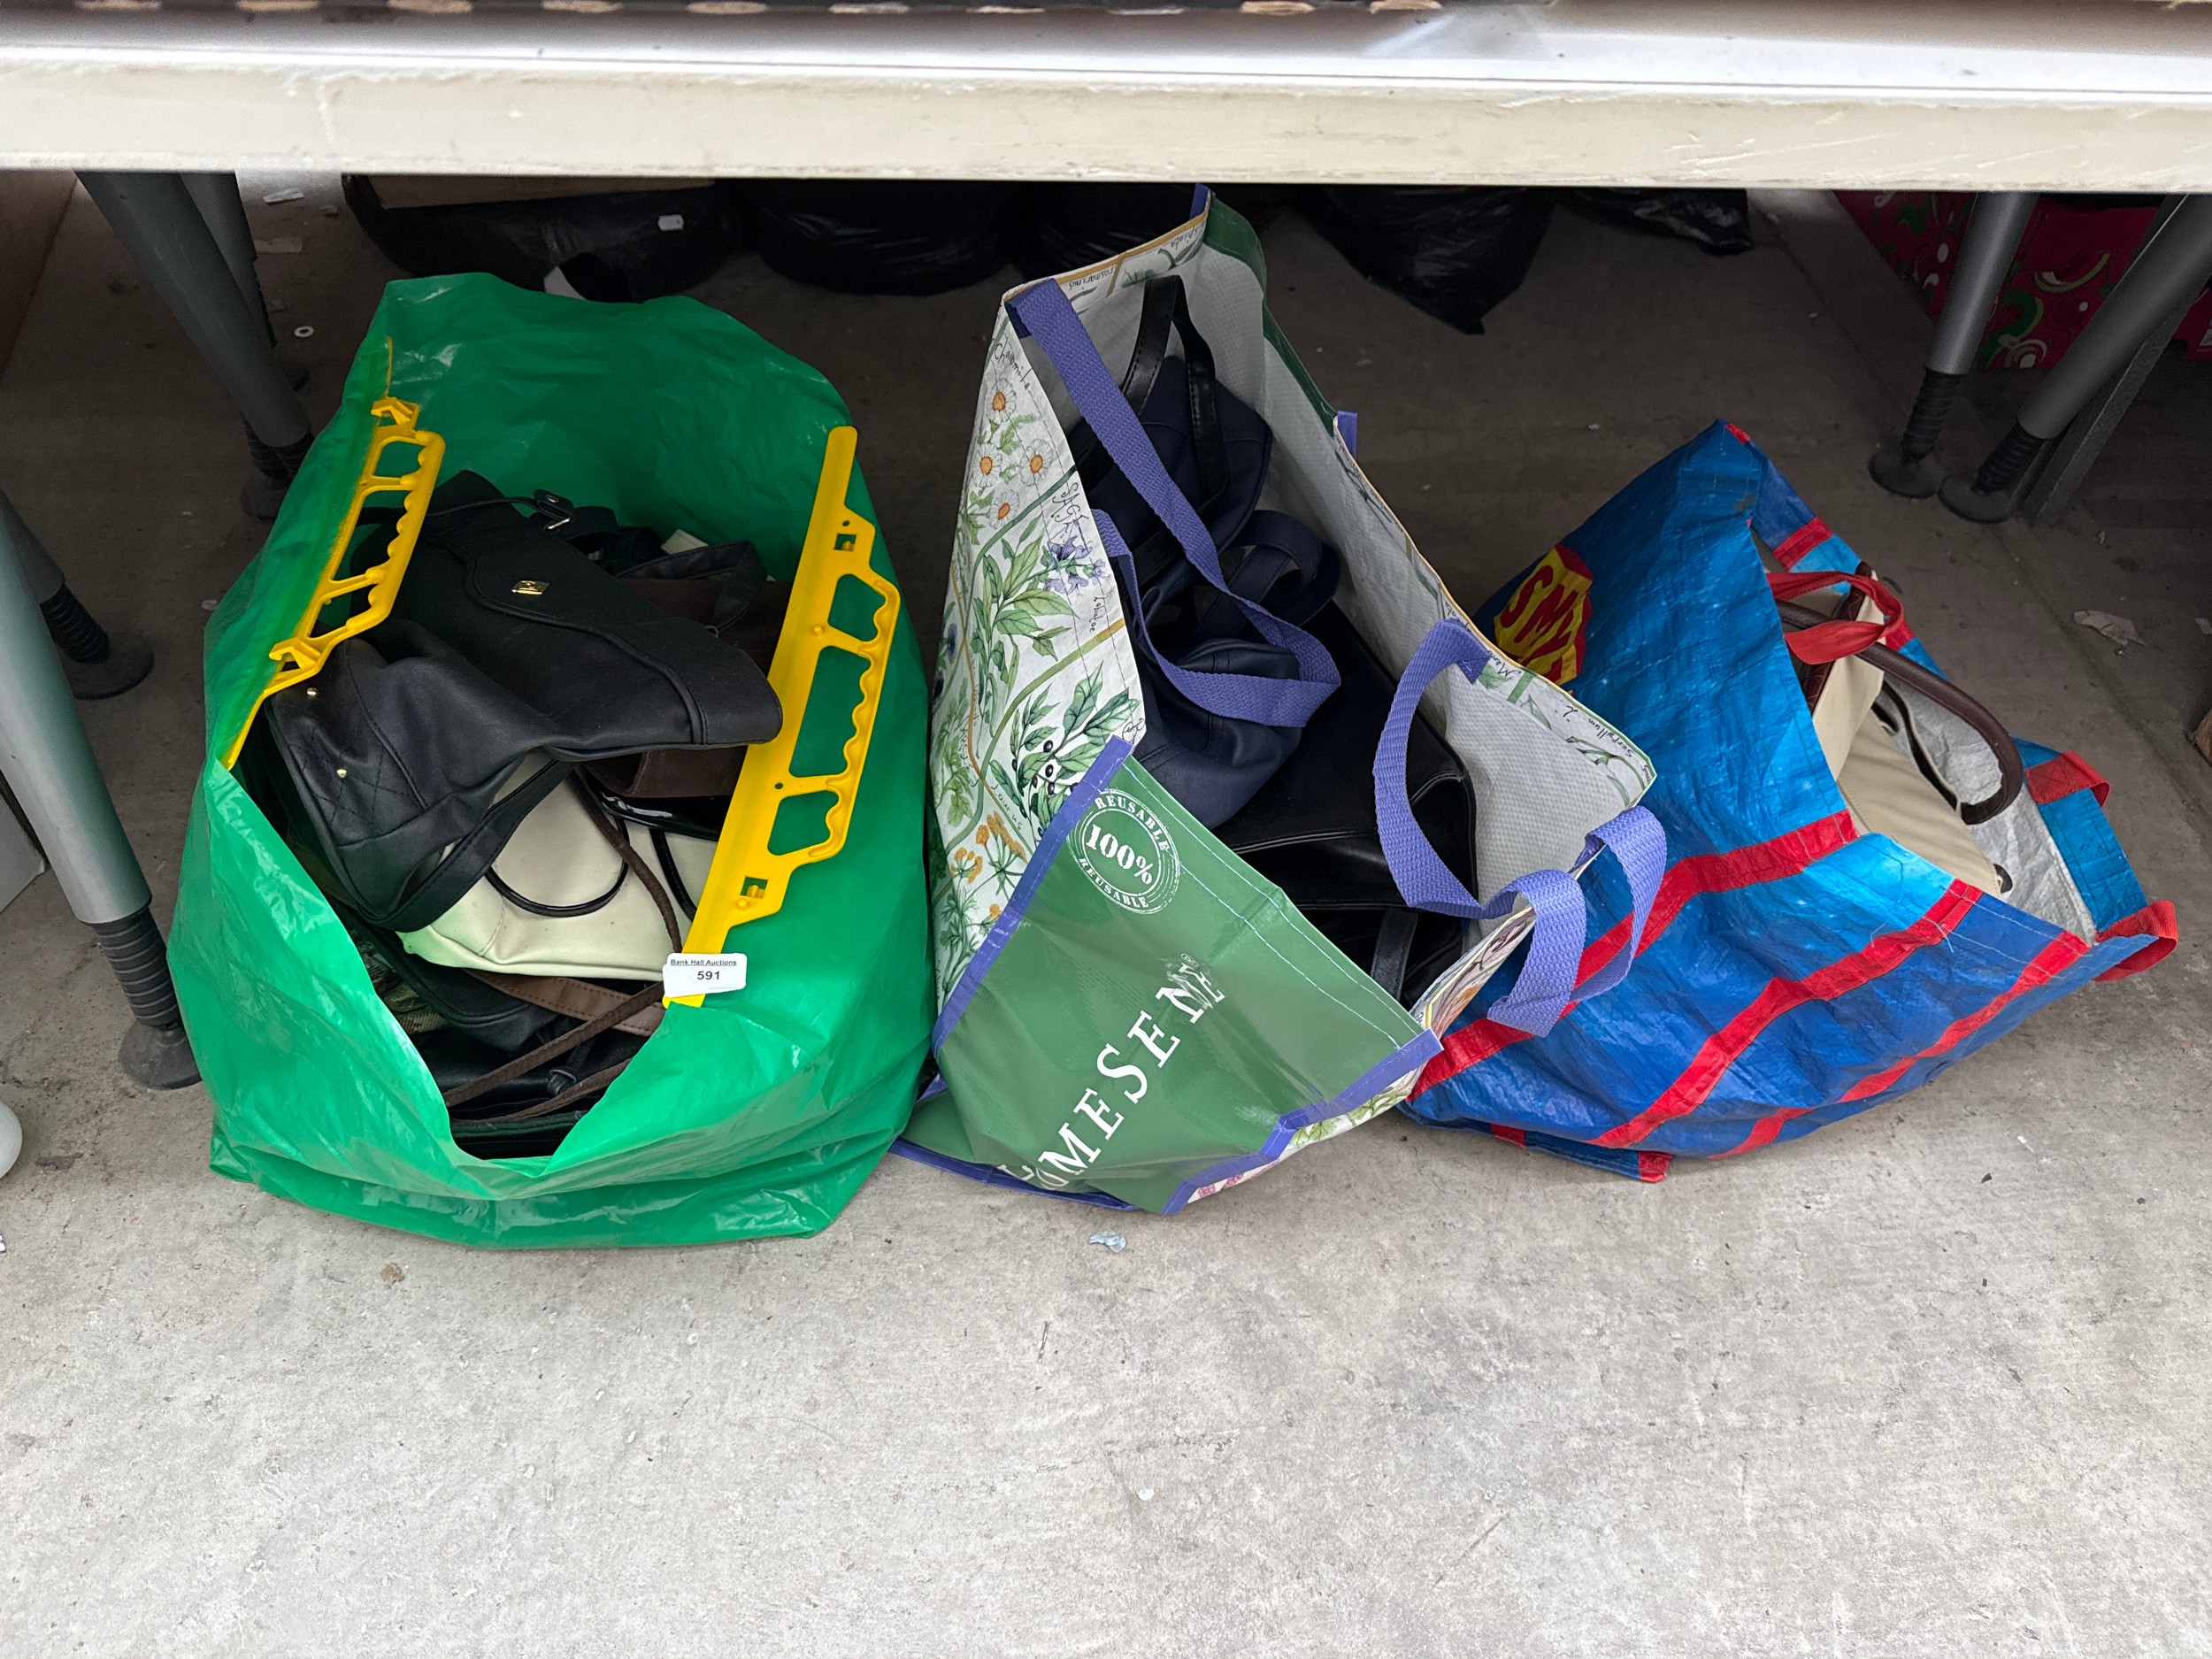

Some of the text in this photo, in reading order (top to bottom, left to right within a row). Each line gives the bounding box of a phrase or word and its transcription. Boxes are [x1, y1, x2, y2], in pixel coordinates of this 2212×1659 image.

[1051, 482, 1089, 534] SAGE
[1094, 795, 1171, 851] REUSABLE
[1086, 824, 1153, 885] 100%
[1078, 858, 1149, 908] REUSABLE
[696, 971, 720, 980] 591
